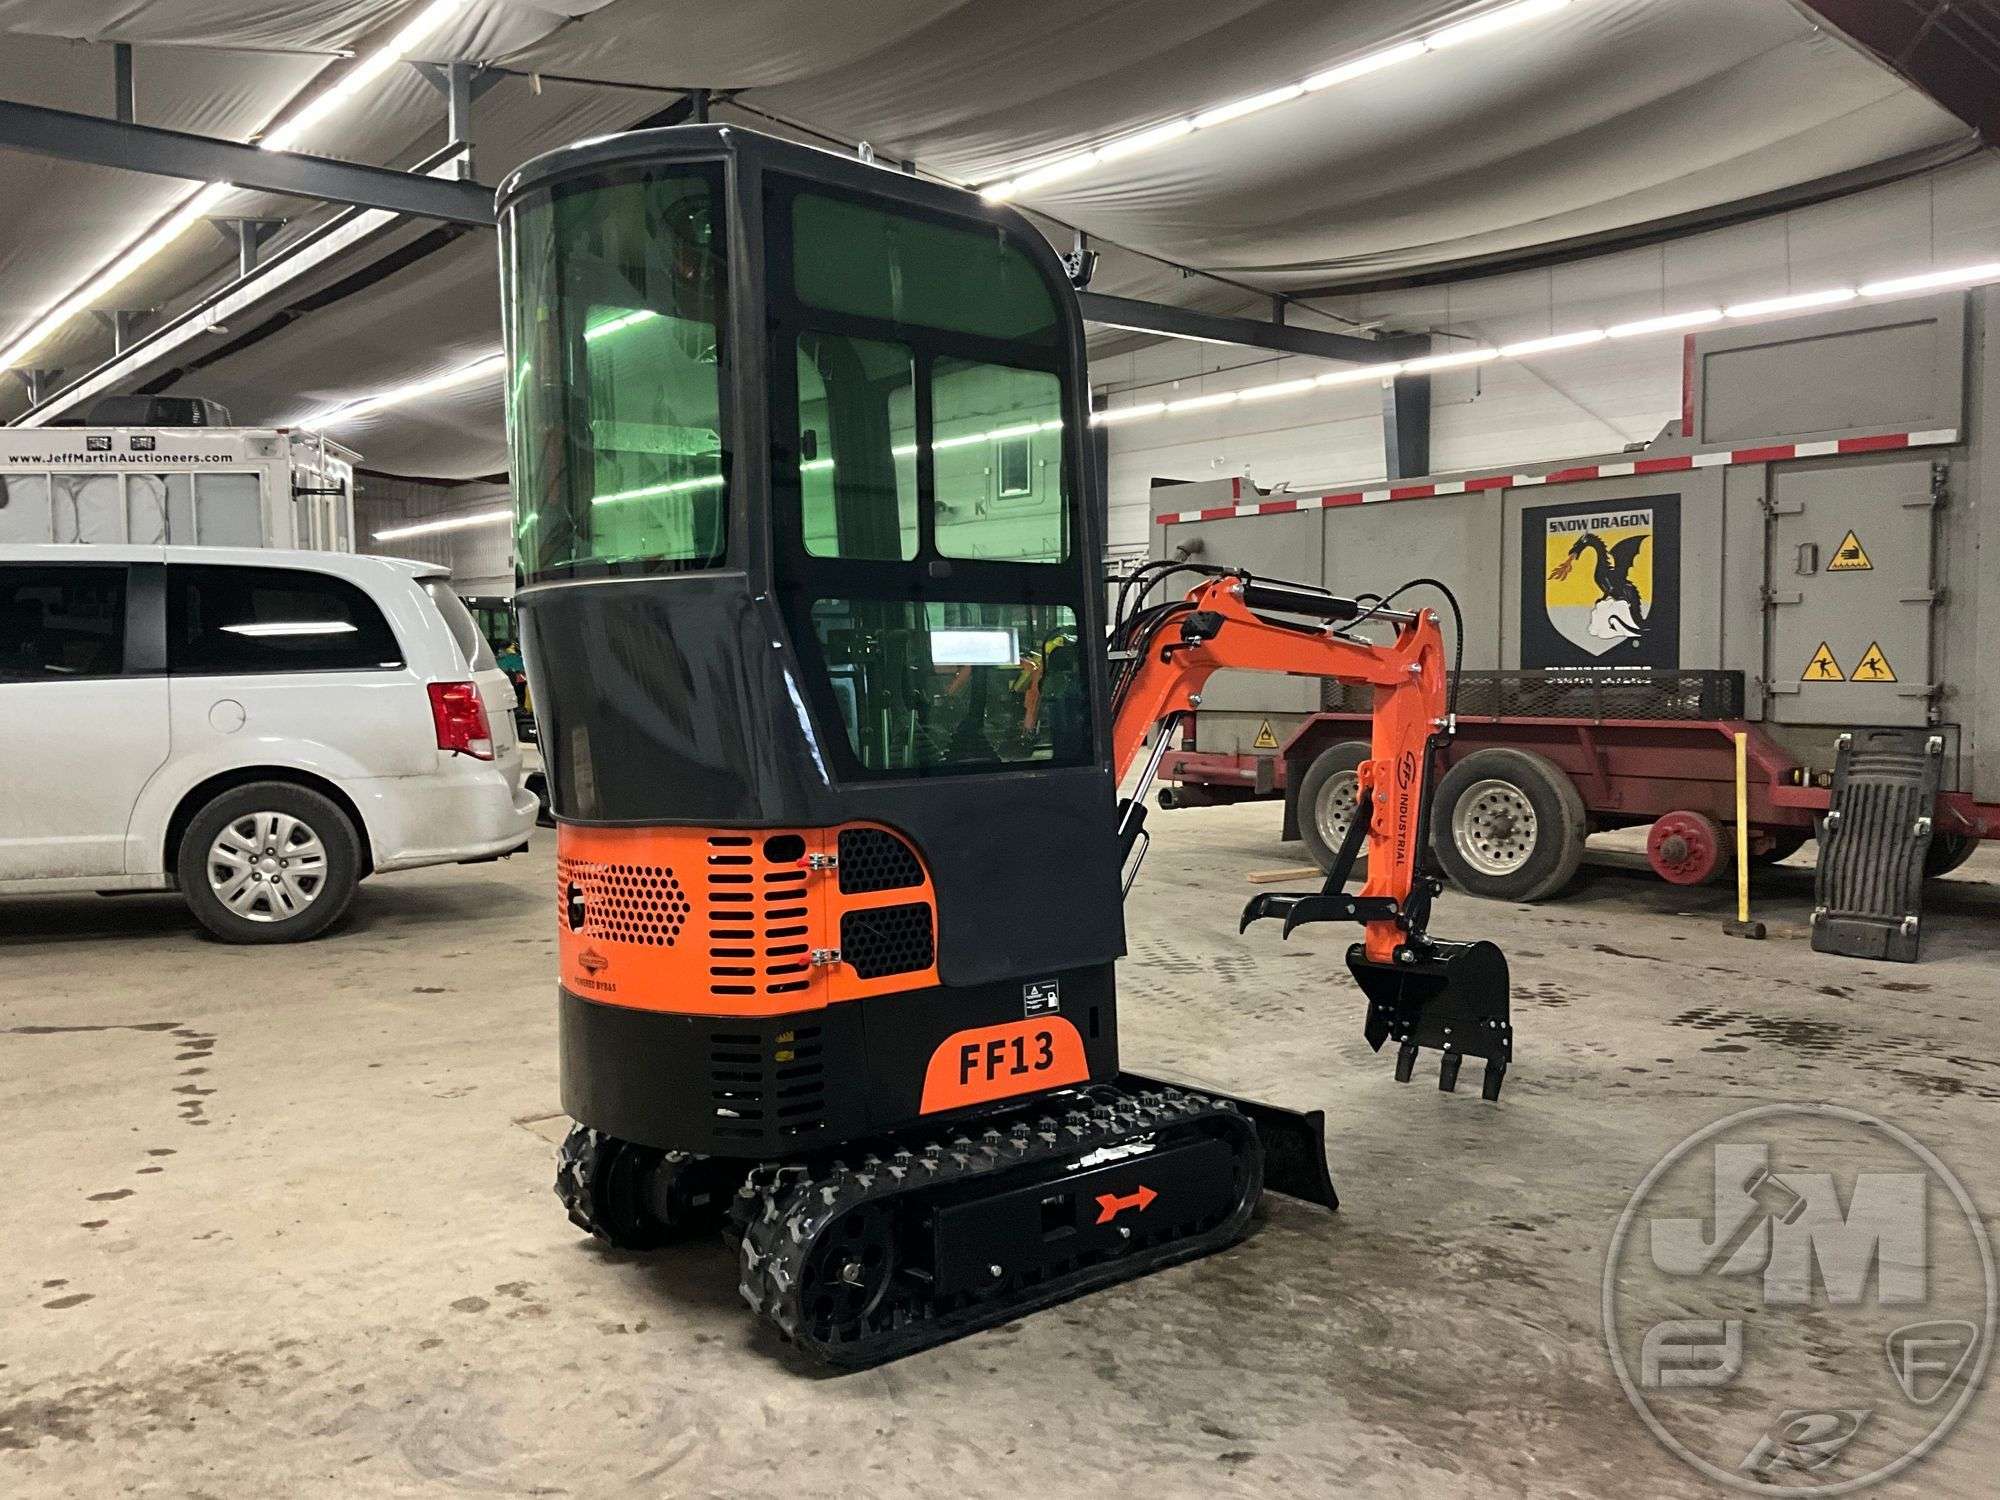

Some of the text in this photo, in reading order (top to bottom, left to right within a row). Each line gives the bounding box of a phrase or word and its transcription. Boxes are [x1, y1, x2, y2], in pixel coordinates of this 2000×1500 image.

[9, 453, 233, 464] www.JeffMartinAuctioneers.com
[1549, 514, 1649, 533] SNOW DRAGON
[1396, 793, 1408, 867] INDUSTRIAL
[960, 1031, 1053, 1085] FF13
